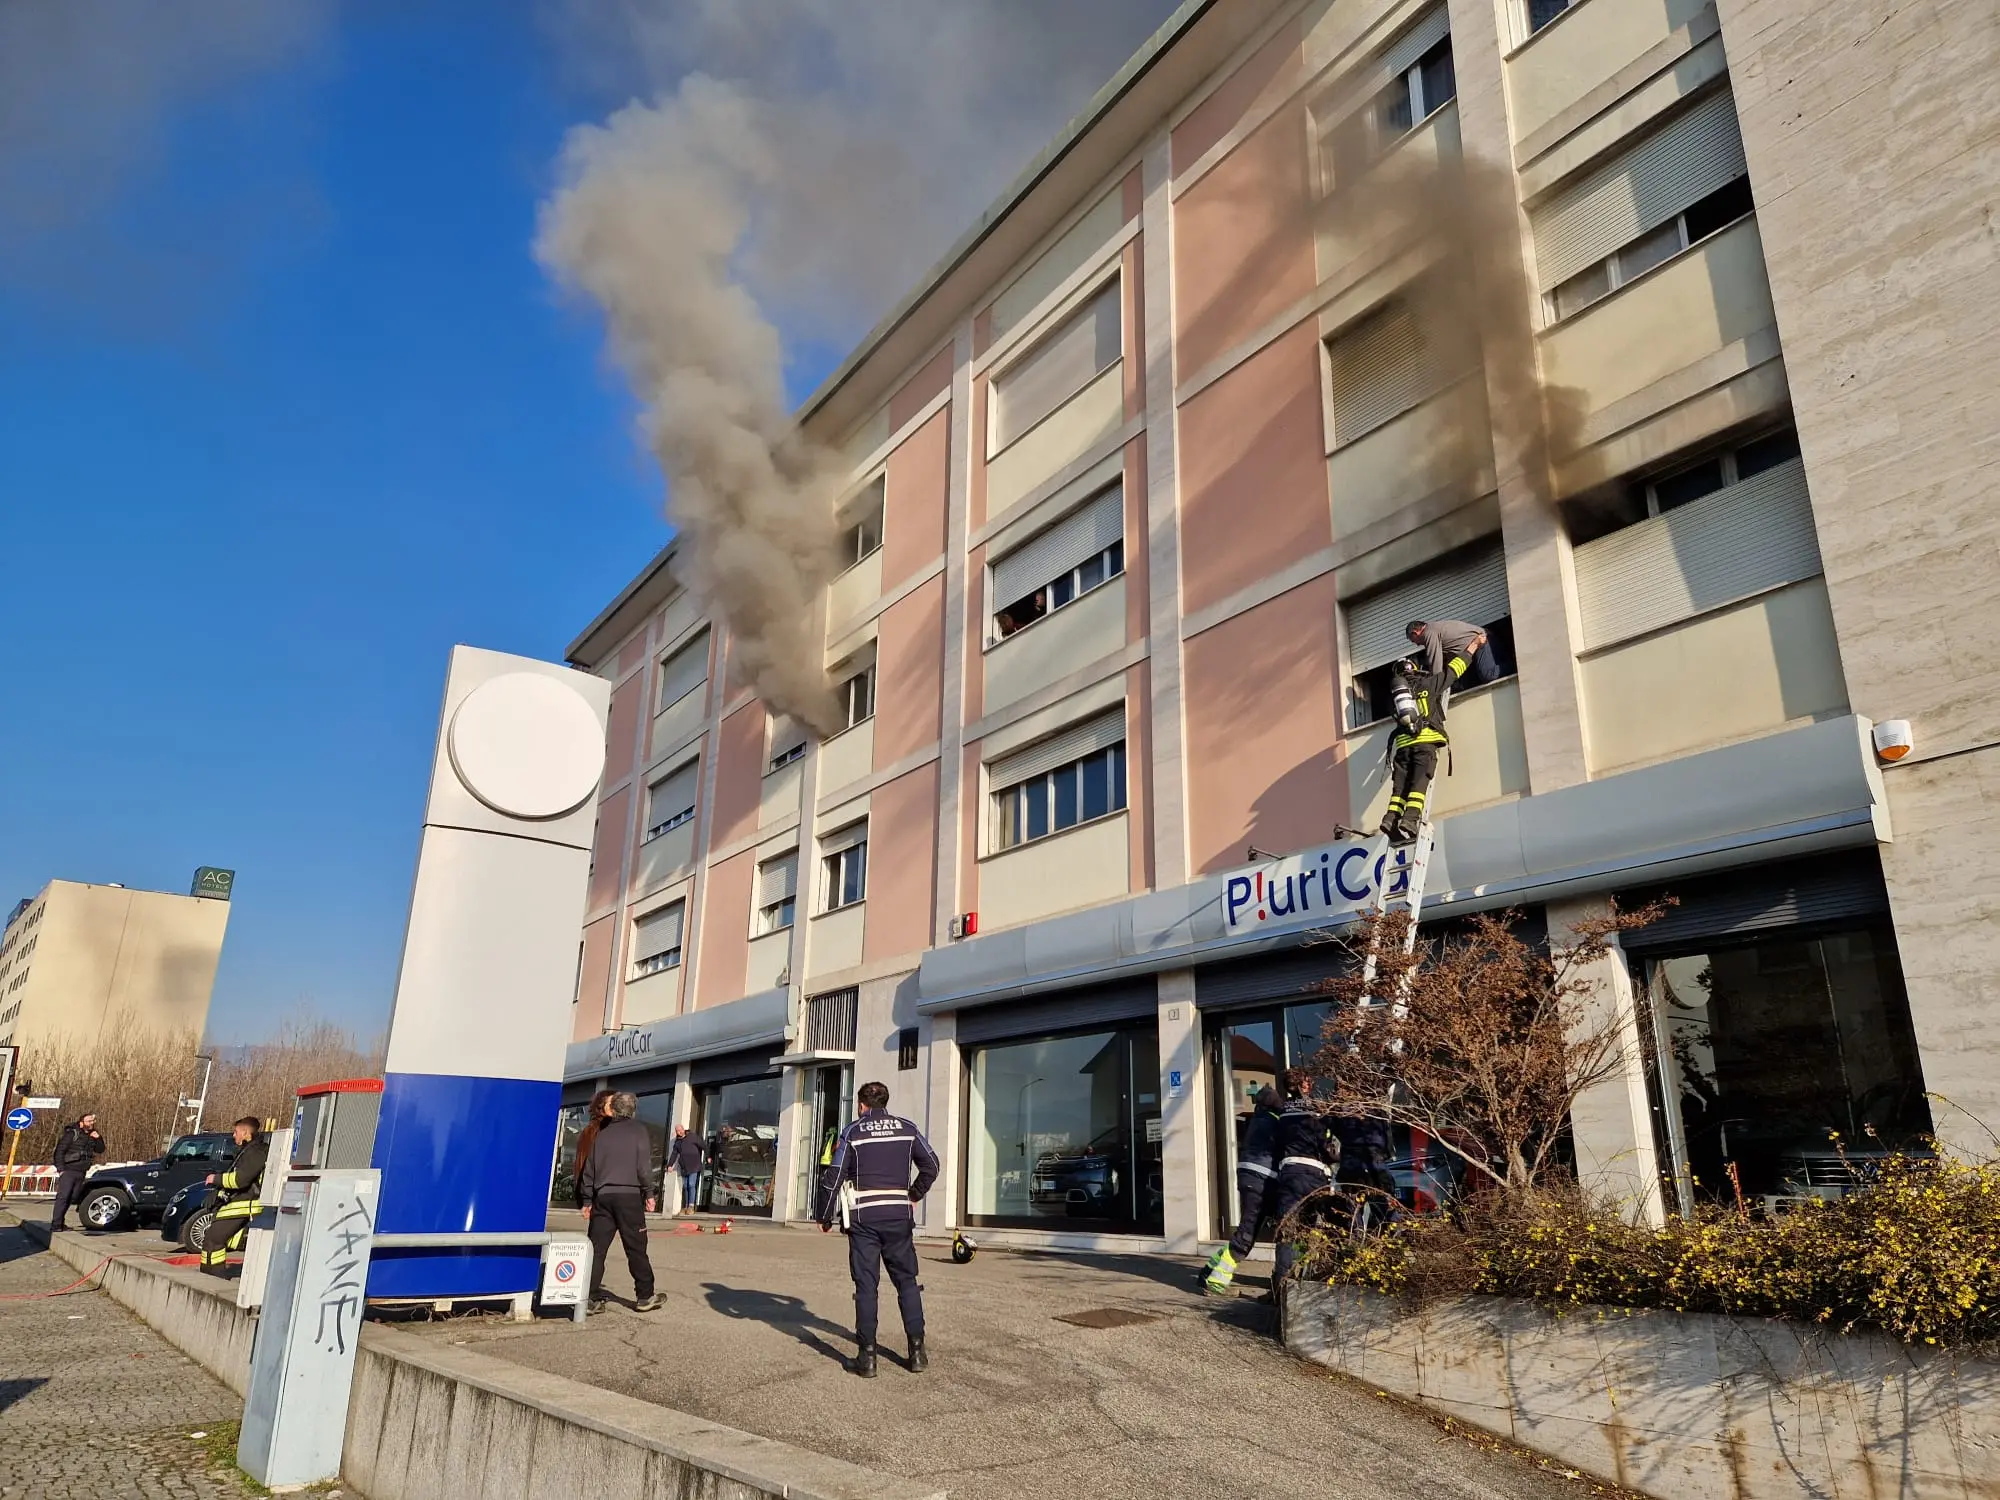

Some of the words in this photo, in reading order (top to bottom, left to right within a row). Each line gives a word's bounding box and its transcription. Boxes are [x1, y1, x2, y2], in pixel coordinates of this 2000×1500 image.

[203, 871, 230, 884] AC
[859, 1119, 902, 1127] POLIZIA
[859, 1123, 903, 1132] LOCALE
